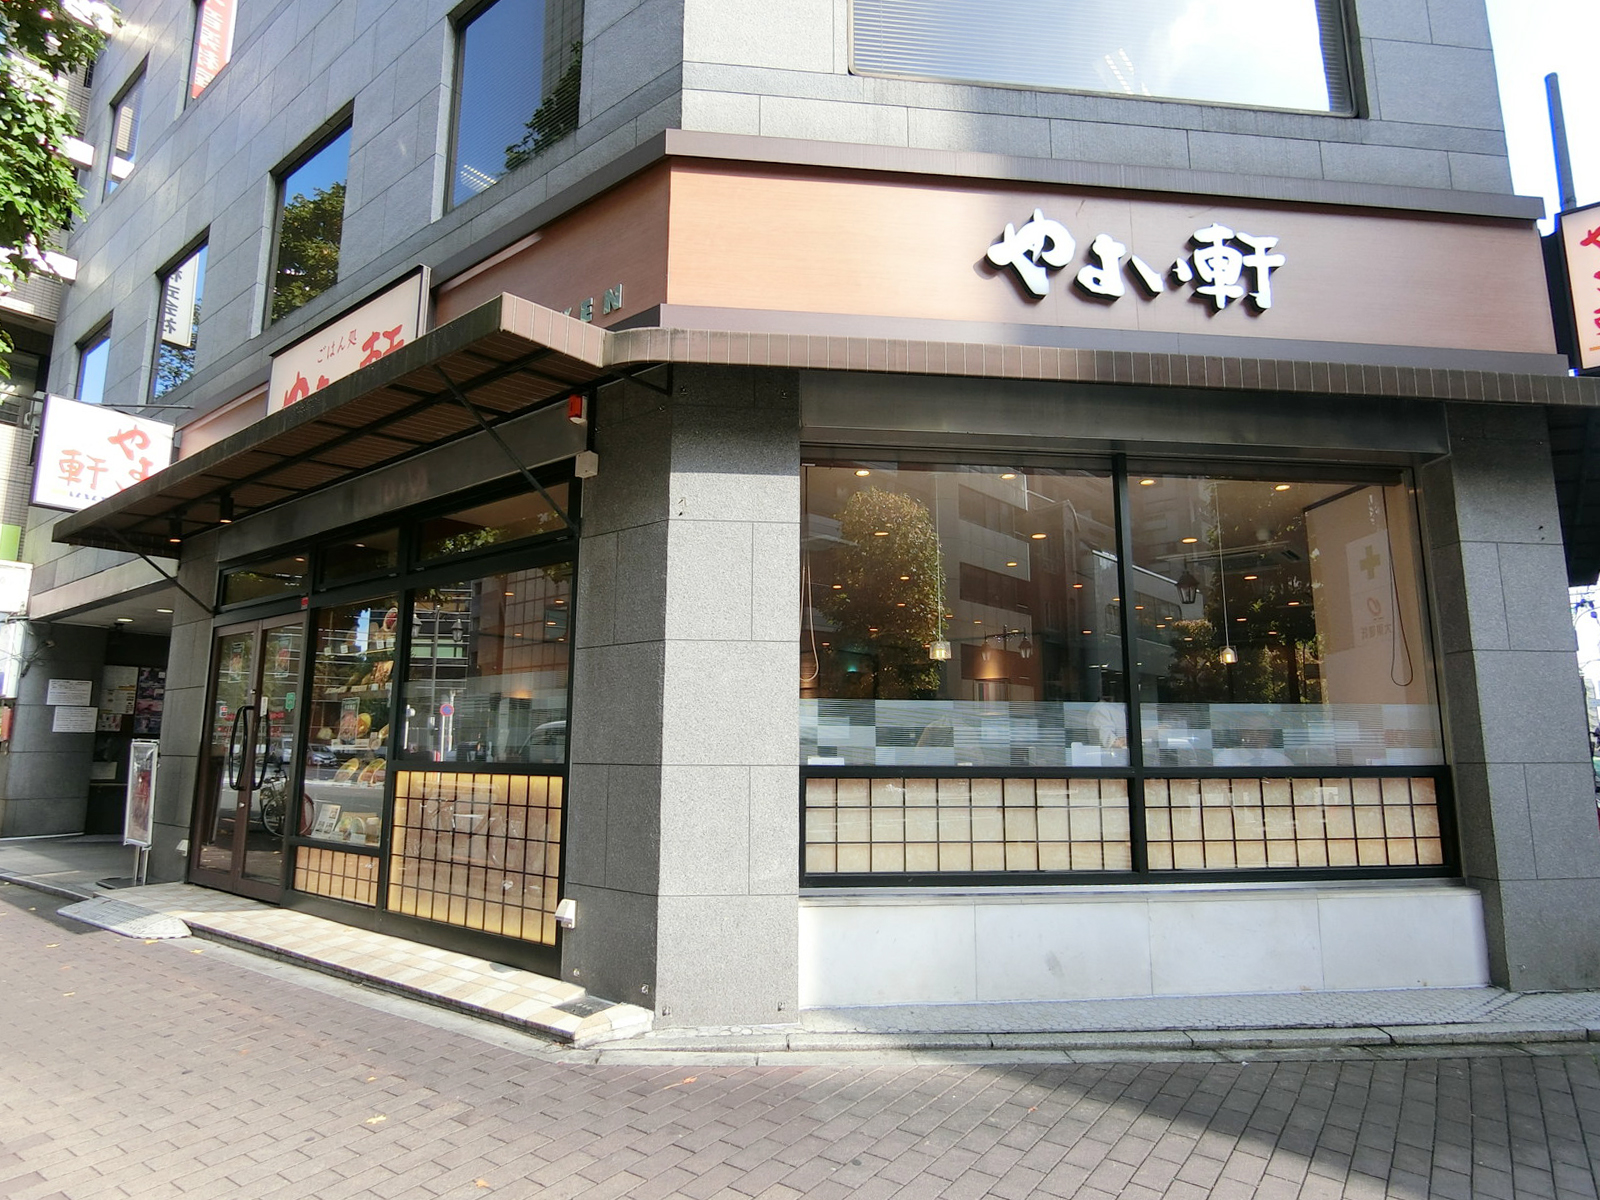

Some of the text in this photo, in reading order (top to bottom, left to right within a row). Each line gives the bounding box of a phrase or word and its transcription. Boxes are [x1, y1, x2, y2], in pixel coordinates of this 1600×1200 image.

[986, 208, 1286, 310] やよい軒
[317, 329, 357, 363] ごはん処
